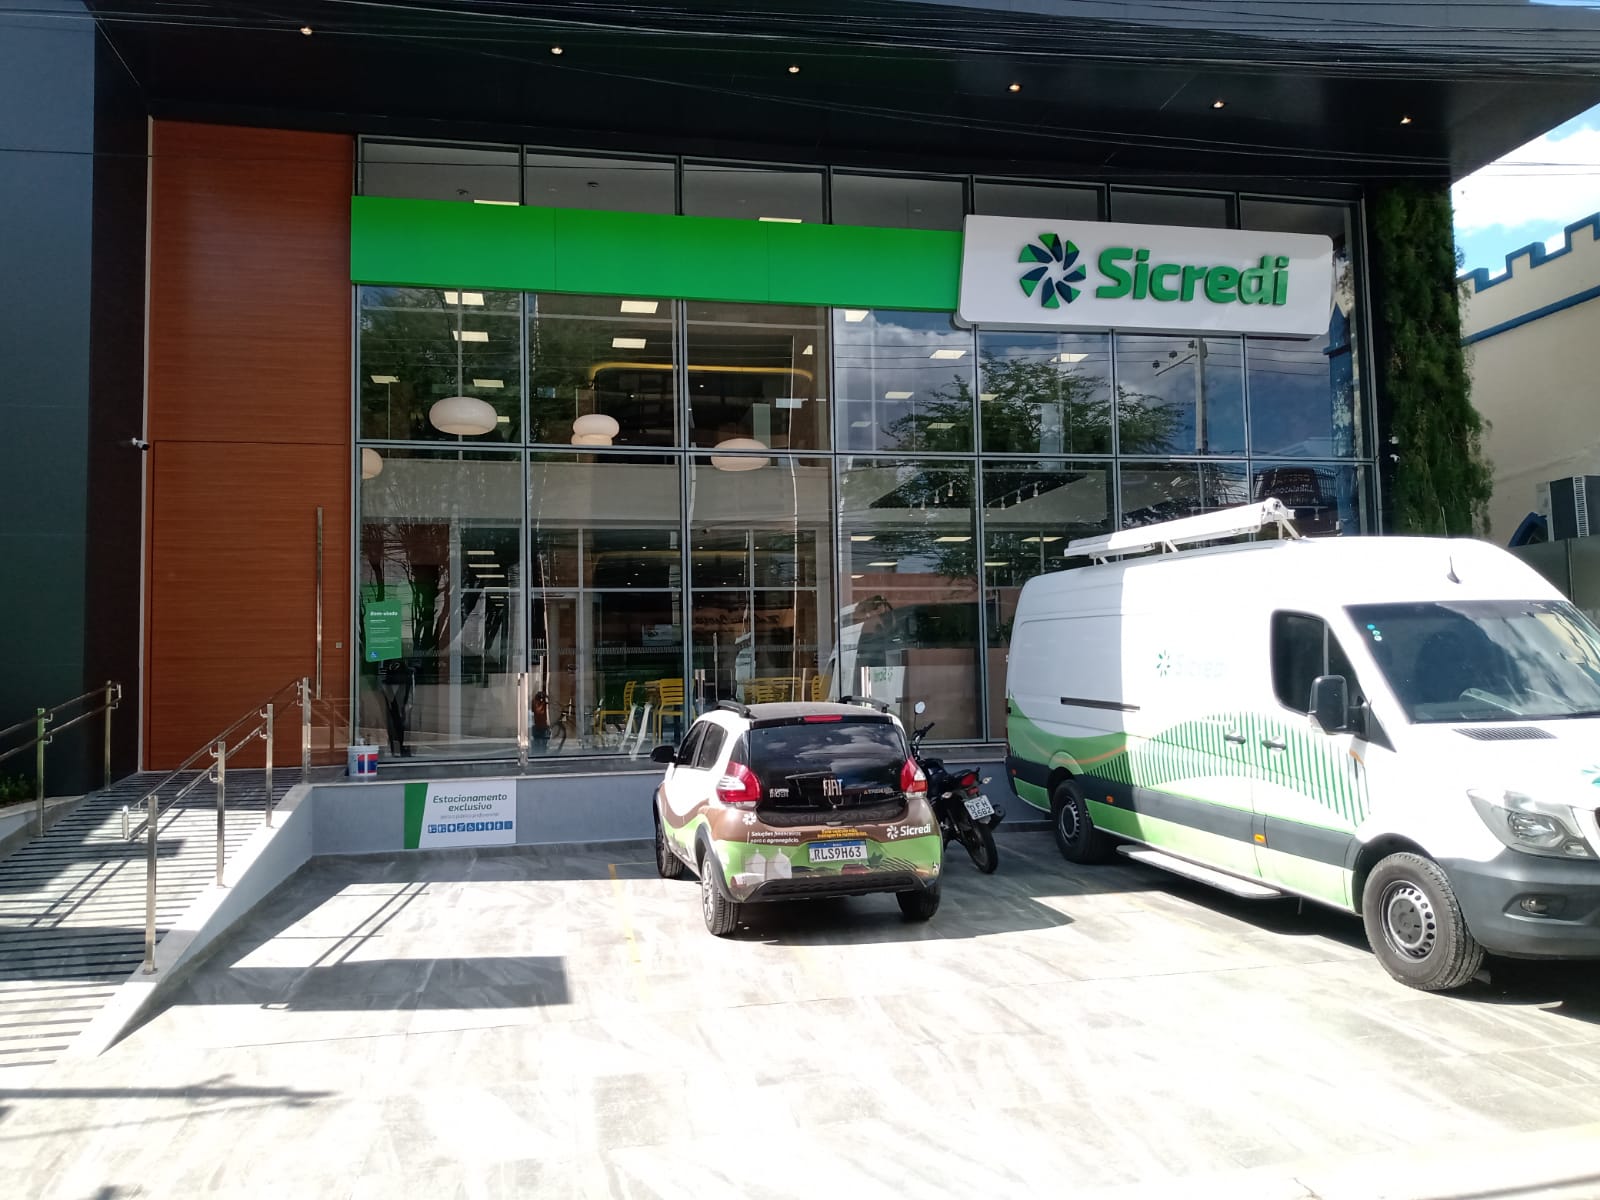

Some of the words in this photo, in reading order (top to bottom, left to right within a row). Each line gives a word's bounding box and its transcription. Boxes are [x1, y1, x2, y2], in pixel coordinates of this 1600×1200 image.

[1096, 247, 1290, 305] Sicredi
[823, 779, 843, 797] FIAT
[432, 793, 508, 804] Estacionamento
[448, 802, 493, 812] exclusivo
[900, 823, 931, 837] Sicredi
[814, 846, 862, 860] RLS9H63
